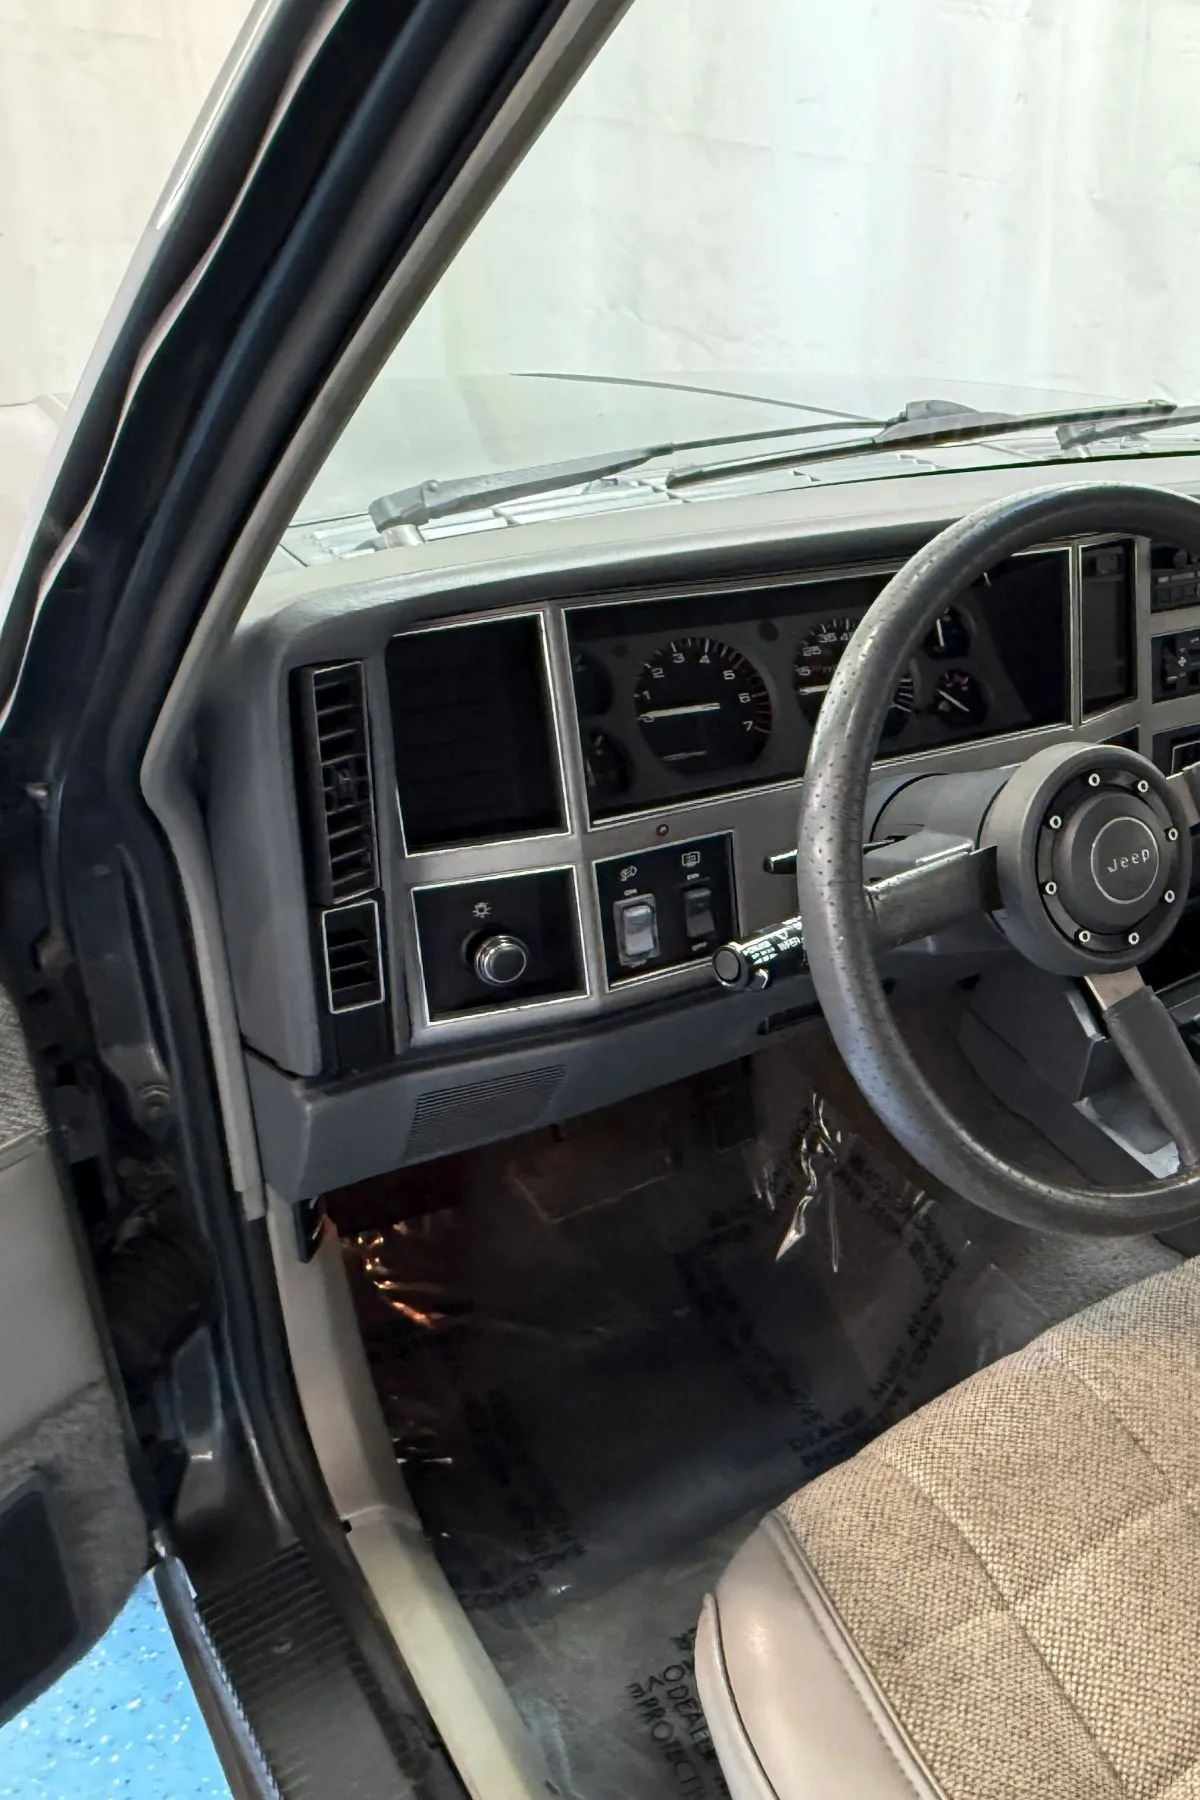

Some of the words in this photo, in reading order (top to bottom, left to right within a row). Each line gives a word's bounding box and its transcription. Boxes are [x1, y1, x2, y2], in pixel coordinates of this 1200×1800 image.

[818, 632, 838, 643] 35
[801, 645, 822, 657] 25
[672, 652, 685, 664] 3
[698, 653, 711, 665] 4
[650, 667, 665, 679] 2
[722, 669, 736, 681] 5
[737, 691, 751, 704] 6
[741, 720, 754, 732] 7
[1106, 848, 1150, 873] Jeep
